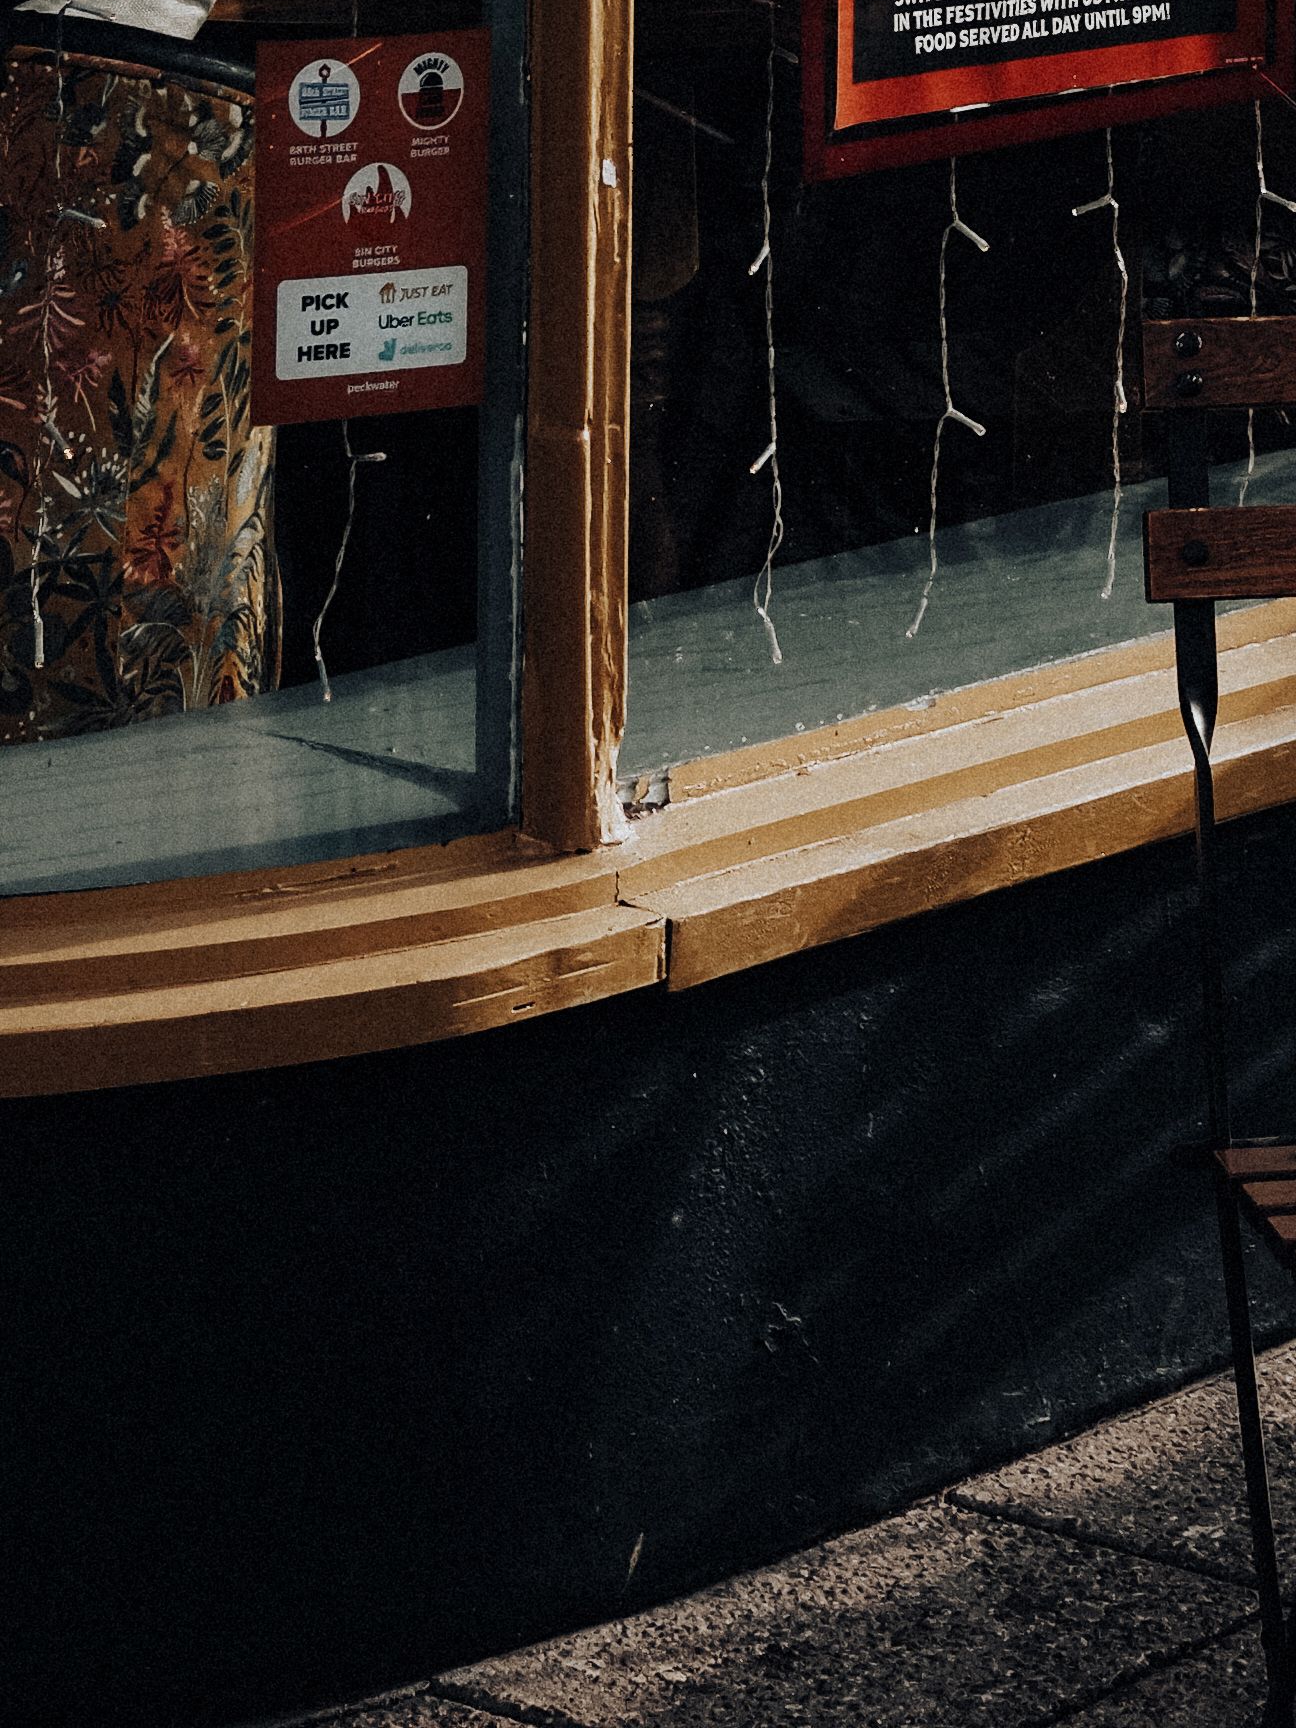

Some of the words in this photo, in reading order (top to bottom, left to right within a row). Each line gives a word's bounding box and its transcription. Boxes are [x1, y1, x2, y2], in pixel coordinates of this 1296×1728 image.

[893, 12, 910, 32] IN
[914, 6, 942, 30] THE
[915, 34, 956, 54] FOOD
[959, 24, 1020, 48] SERVED
[1022, 17, 1050, 40] ALL
[1052, 12, 1082, 36] DAY
[1084, 8, 1130, 31] UNTIL
[1132, 2, 1170, 24] 9PM!
[413, 57, 450, 76] MIGHTY
[320, 142, 358, 153] STREET
[411, 135, 449, 147] MIGHTY
[289, 155, 332, 165] BURGER
[410, 146, 450, 158] BURGER
[374, 245, 399, 254] CITY
[352, 256, 401, 269] BURGERS
[302, 292, 350, 311] PICK
[399, 286, 429, 302] JUST
[432, 284, 453, 296] EAT
[311, 319, 339, 335] UP
[378, 314, 415, 329] Uber
[417, 311, 453, 326] Eats
[297, 342, 351, 362] HERE
